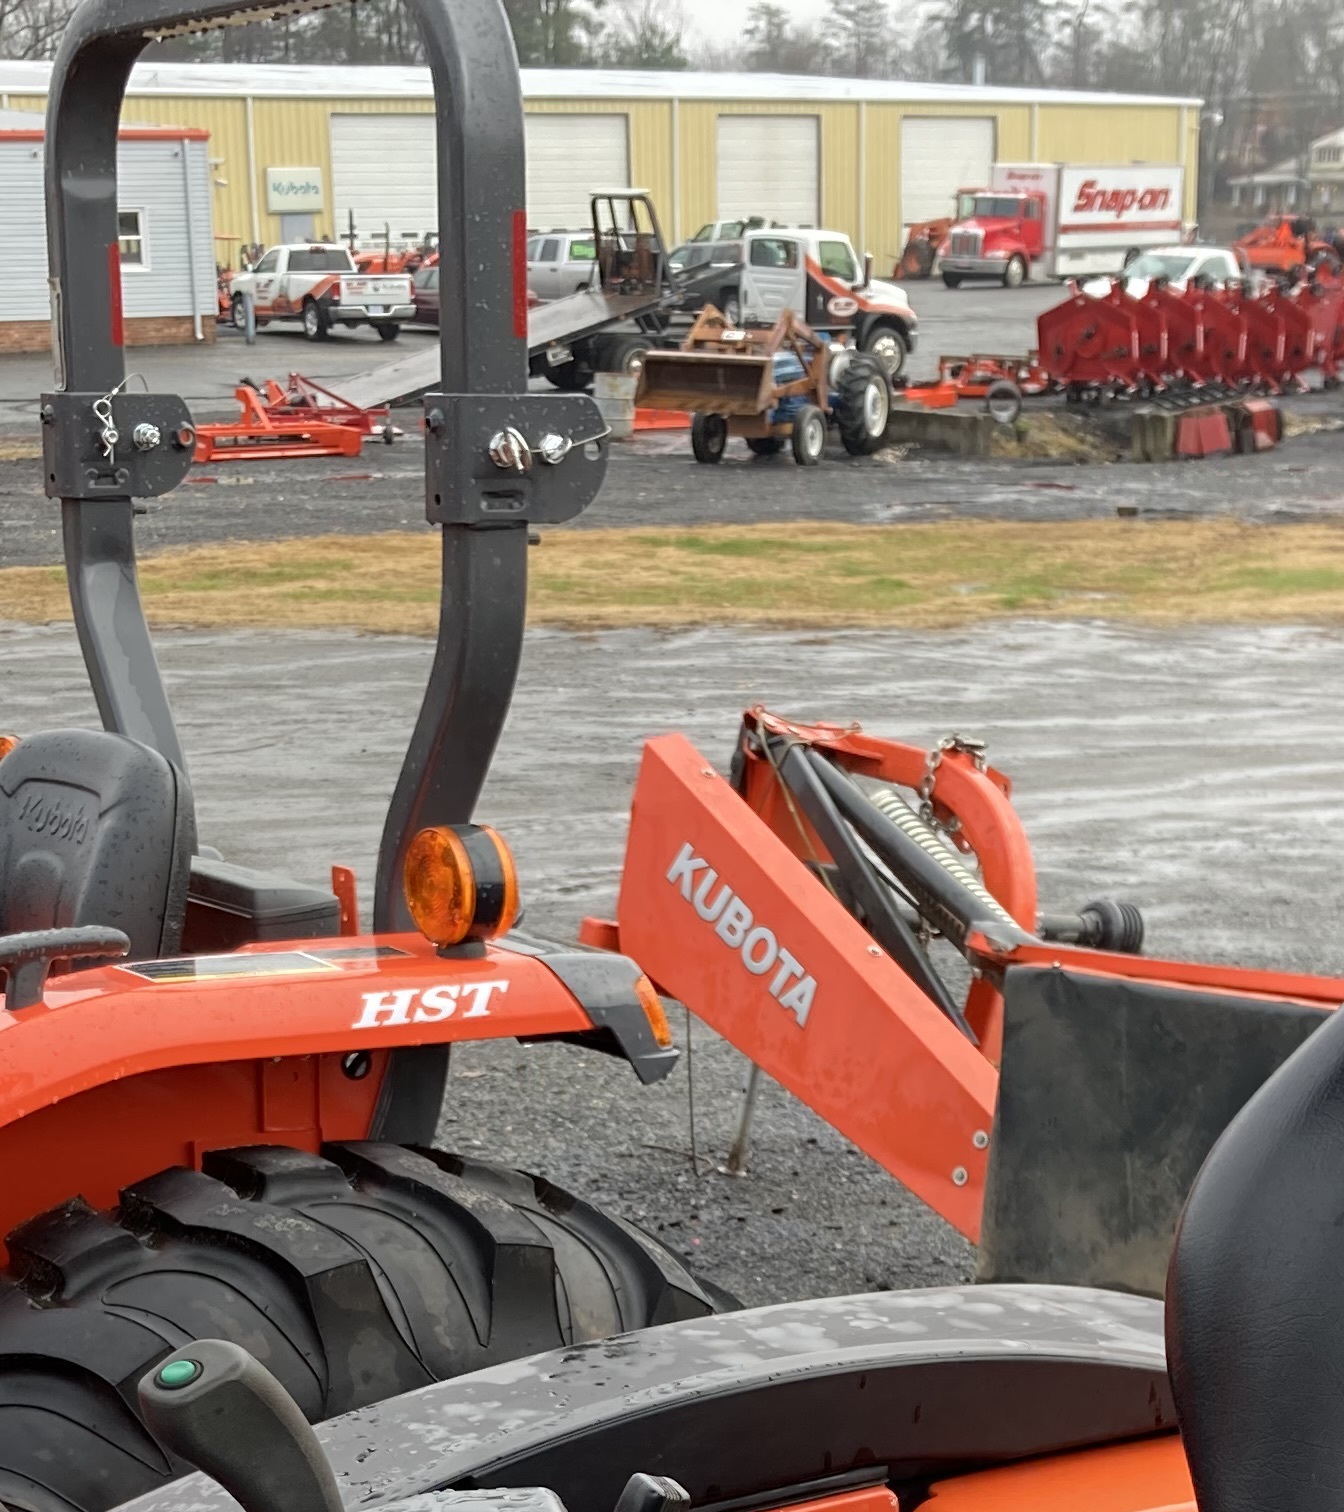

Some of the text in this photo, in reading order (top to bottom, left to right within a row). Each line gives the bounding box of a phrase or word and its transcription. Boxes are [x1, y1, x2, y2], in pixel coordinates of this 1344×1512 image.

[1073, 179, 1172, 219] Snap-on
[18, 796, 90, 846] Kubota
[666, 841, 818, 1029] KUBOTA
[351, 980, 509, 1029] HST
